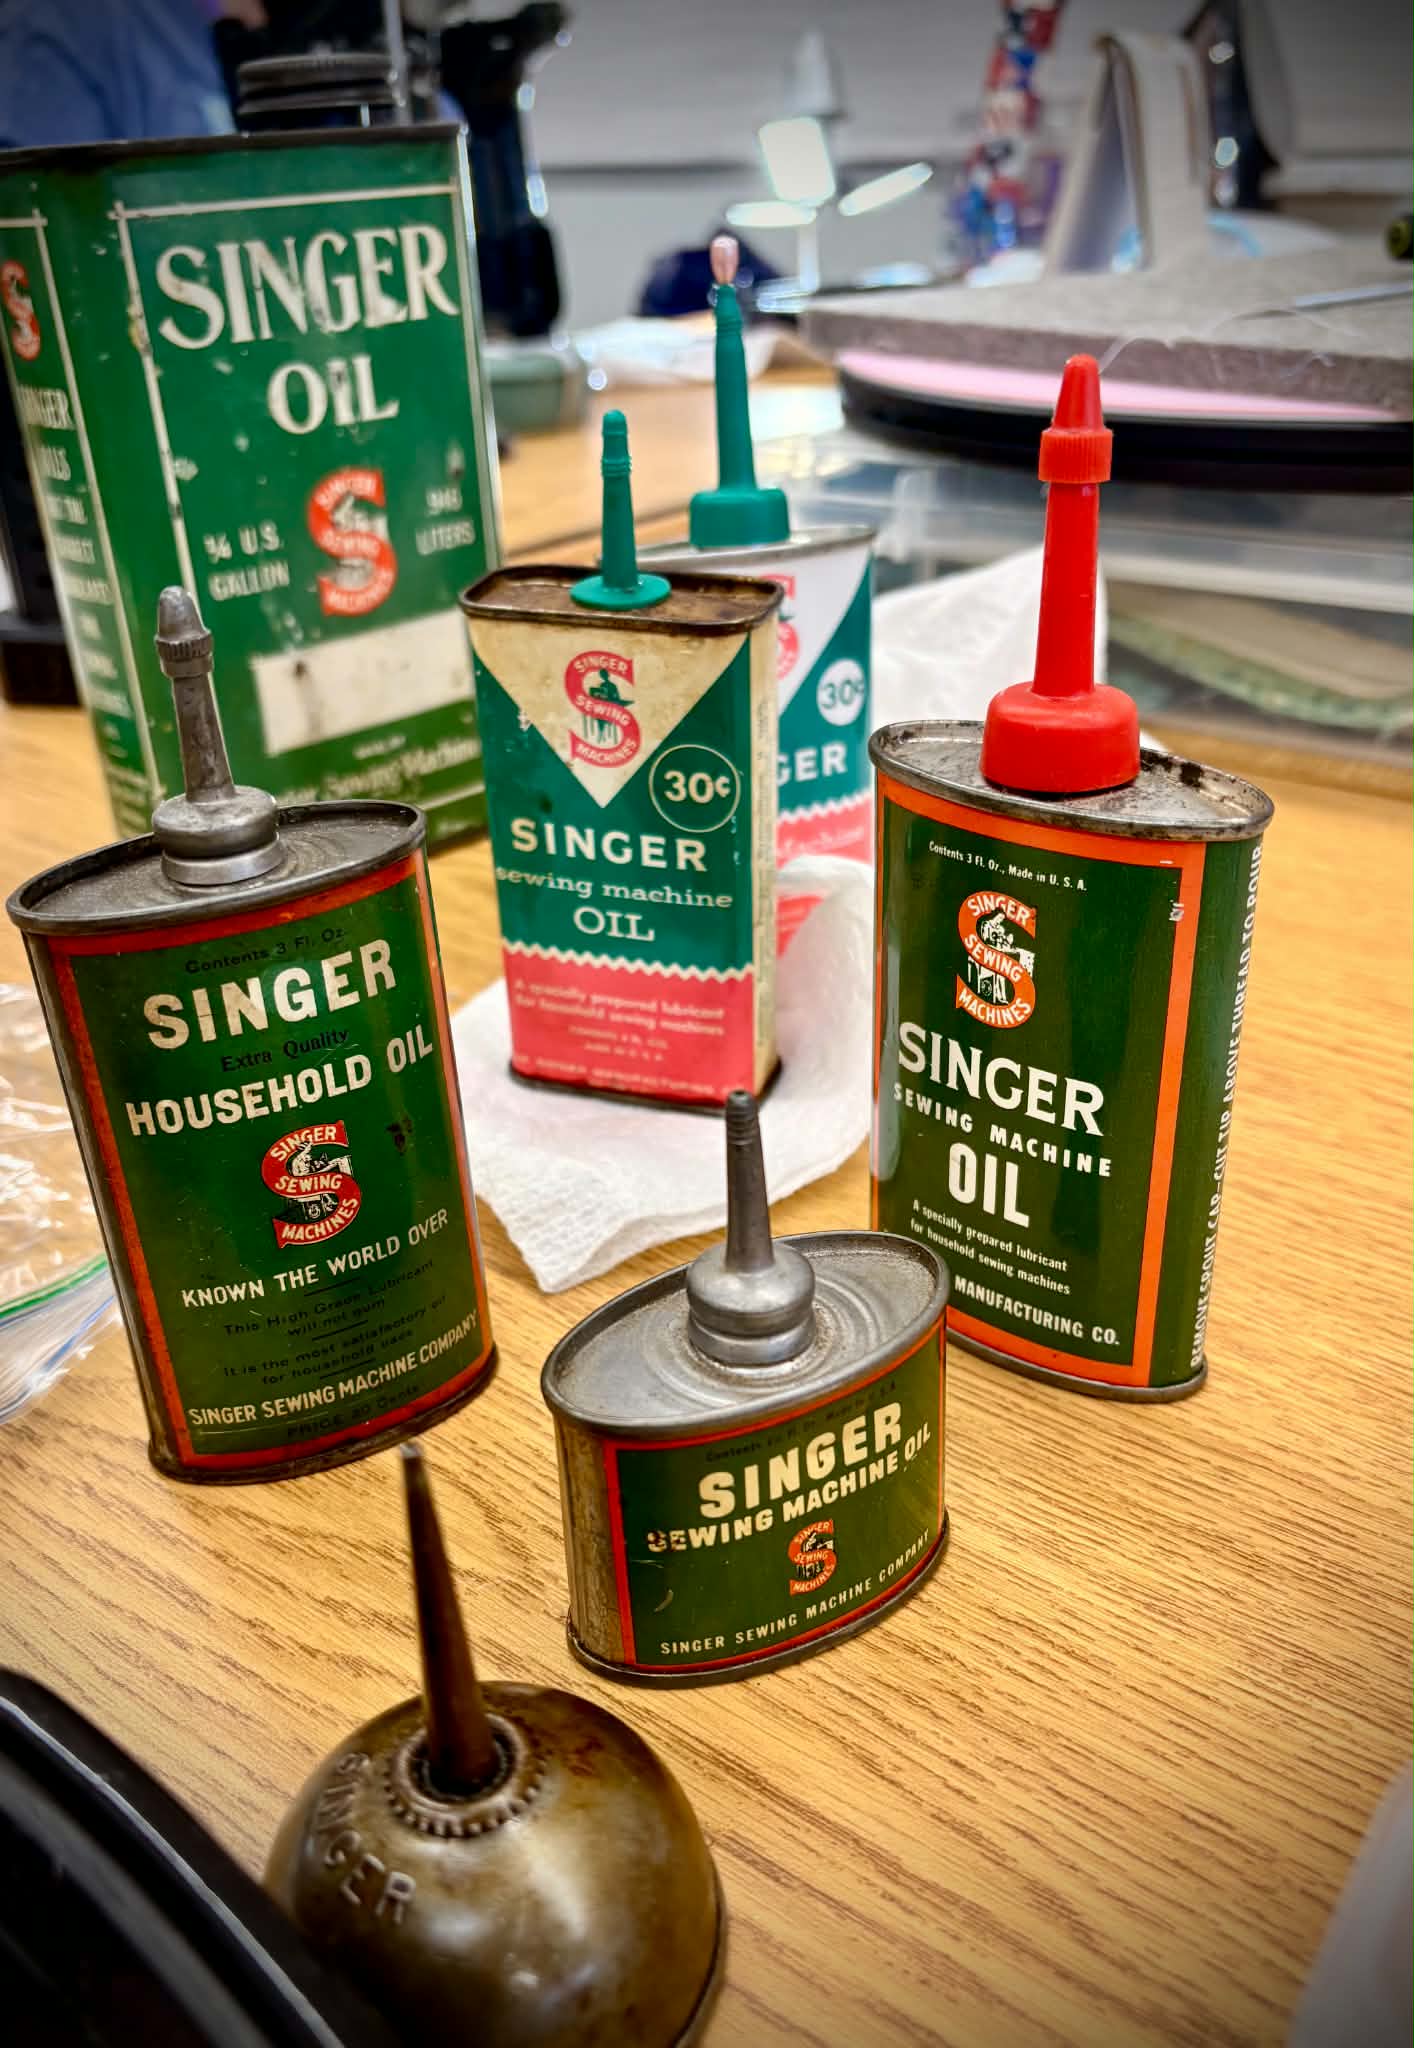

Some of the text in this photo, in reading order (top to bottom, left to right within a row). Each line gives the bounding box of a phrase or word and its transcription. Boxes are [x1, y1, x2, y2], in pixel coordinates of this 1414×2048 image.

[156, 224, 460, 350] SINGER
[266, 354, 400, 435] OIL
[572, 656, 629, 676] SINGER
[575, 694, 631, 727] SEWING
[663, 769, 731, 804] 30¢
[511, 817, 708, 873] SINGER
[928, 840, 965, 862] Contents
[966, 853, 974, 864] 3
[1008, 863, 1034, 881] Made
[1036, 871, 1046, 883] in
[496, 866, 734, 908] sewing machine
[966, 893, 1032, 928] SINGER
[573, 906, 656, 941] OIL
[184, 948, 270, 974] Contents
[276, 941, 287, 955] 3
[964, 932, 1025, 984] SEWING
[143, 939, 396, 1050] SINGER
[958, 986, 1032, 1026] MACHINES
[221, 1029, 349, 1073] Extra Quality
[126, 1024, 434, 1137] HOUSEHOLD OIL
[898, 1020, 1106, 1138] SINGER
[270, 1125, 337, 1162] SINGER
[893, 1082, 1113, 1178] SEWING MACHINE
[274, 1173, 343, 1194] SEWING
[948, 1141, 1031, 1229] OIL
[281, 1197, 359, 1241] MACHINES
[912, 1199, 1068, 1273] A specially prepared lubricant
[181, 1208, 449, 1308] KNOWN THE WORLD OVER
[910, 1217, 1071, 1295] for household sewing machines
[223, 1322, 261, 1337] This
[266, 1307, 309, 1330] High
[954, 1274, 1122, 1346] MANUFACTURING CO.
[189, 1309, 479, 1427] SINGER SEWING MACHINE COMPANY
[647, 1420, 932, 1553] SEWING MACHINE OIL
[698, 1402, 903, 1519] SINGER
[794, 1550, 829, 1564] SEWING
[660, 1527, 930, 1656] SINGER SEWING MACHINE COMPANY
